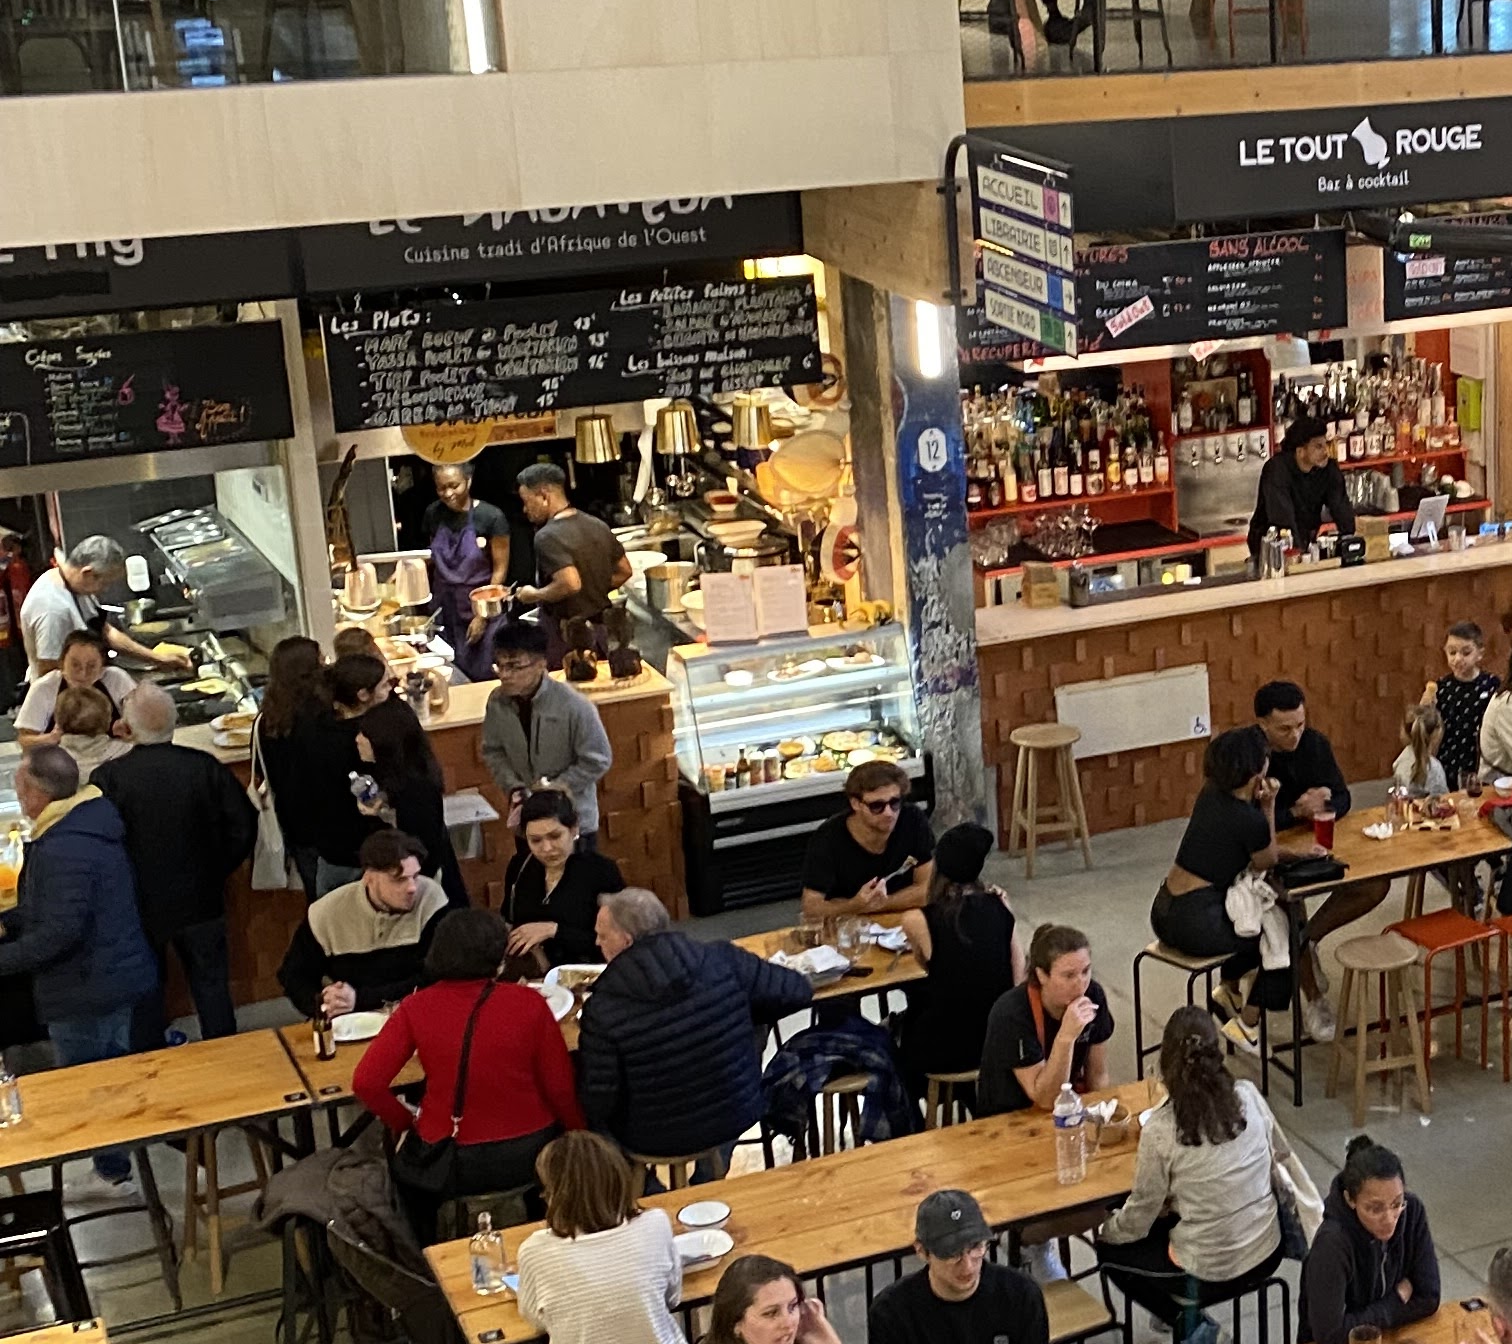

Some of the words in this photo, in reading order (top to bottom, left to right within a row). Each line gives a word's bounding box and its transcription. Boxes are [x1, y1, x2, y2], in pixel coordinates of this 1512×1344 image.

[1239, 139, 1274, 167] LE
[1279, 133, 1348, 164] TOUT
[1396, 124, 1482, 156] ROUGE
[981, 175, 1039, 211] ACCUEIL
[1317, 176, 1341, 193] Bar
[1345, 174, 1354, 190] à
[1358, 169, 1410, 190] cocktail
[404, 245, 470, 264] Cuisine
[477, 239, 523, 259] tradi
[530, 234, 611, 255] d'Afrique
[618, 230, 638, 248] de
[644, 226, 707, 246] l'Ouest
[984, 215, 1041, 254] LIBRAIRIE
[1209, 237, 1249, 258] SANS
[1253, 234, 1310, 257] ALCOOL
[987, 255, 1044, 295] ASCENSEUR
[330, 316, 359, 334] Les
[989, 297, 1014, 324] SORTIE
[926, 439, 941, 462] 12
